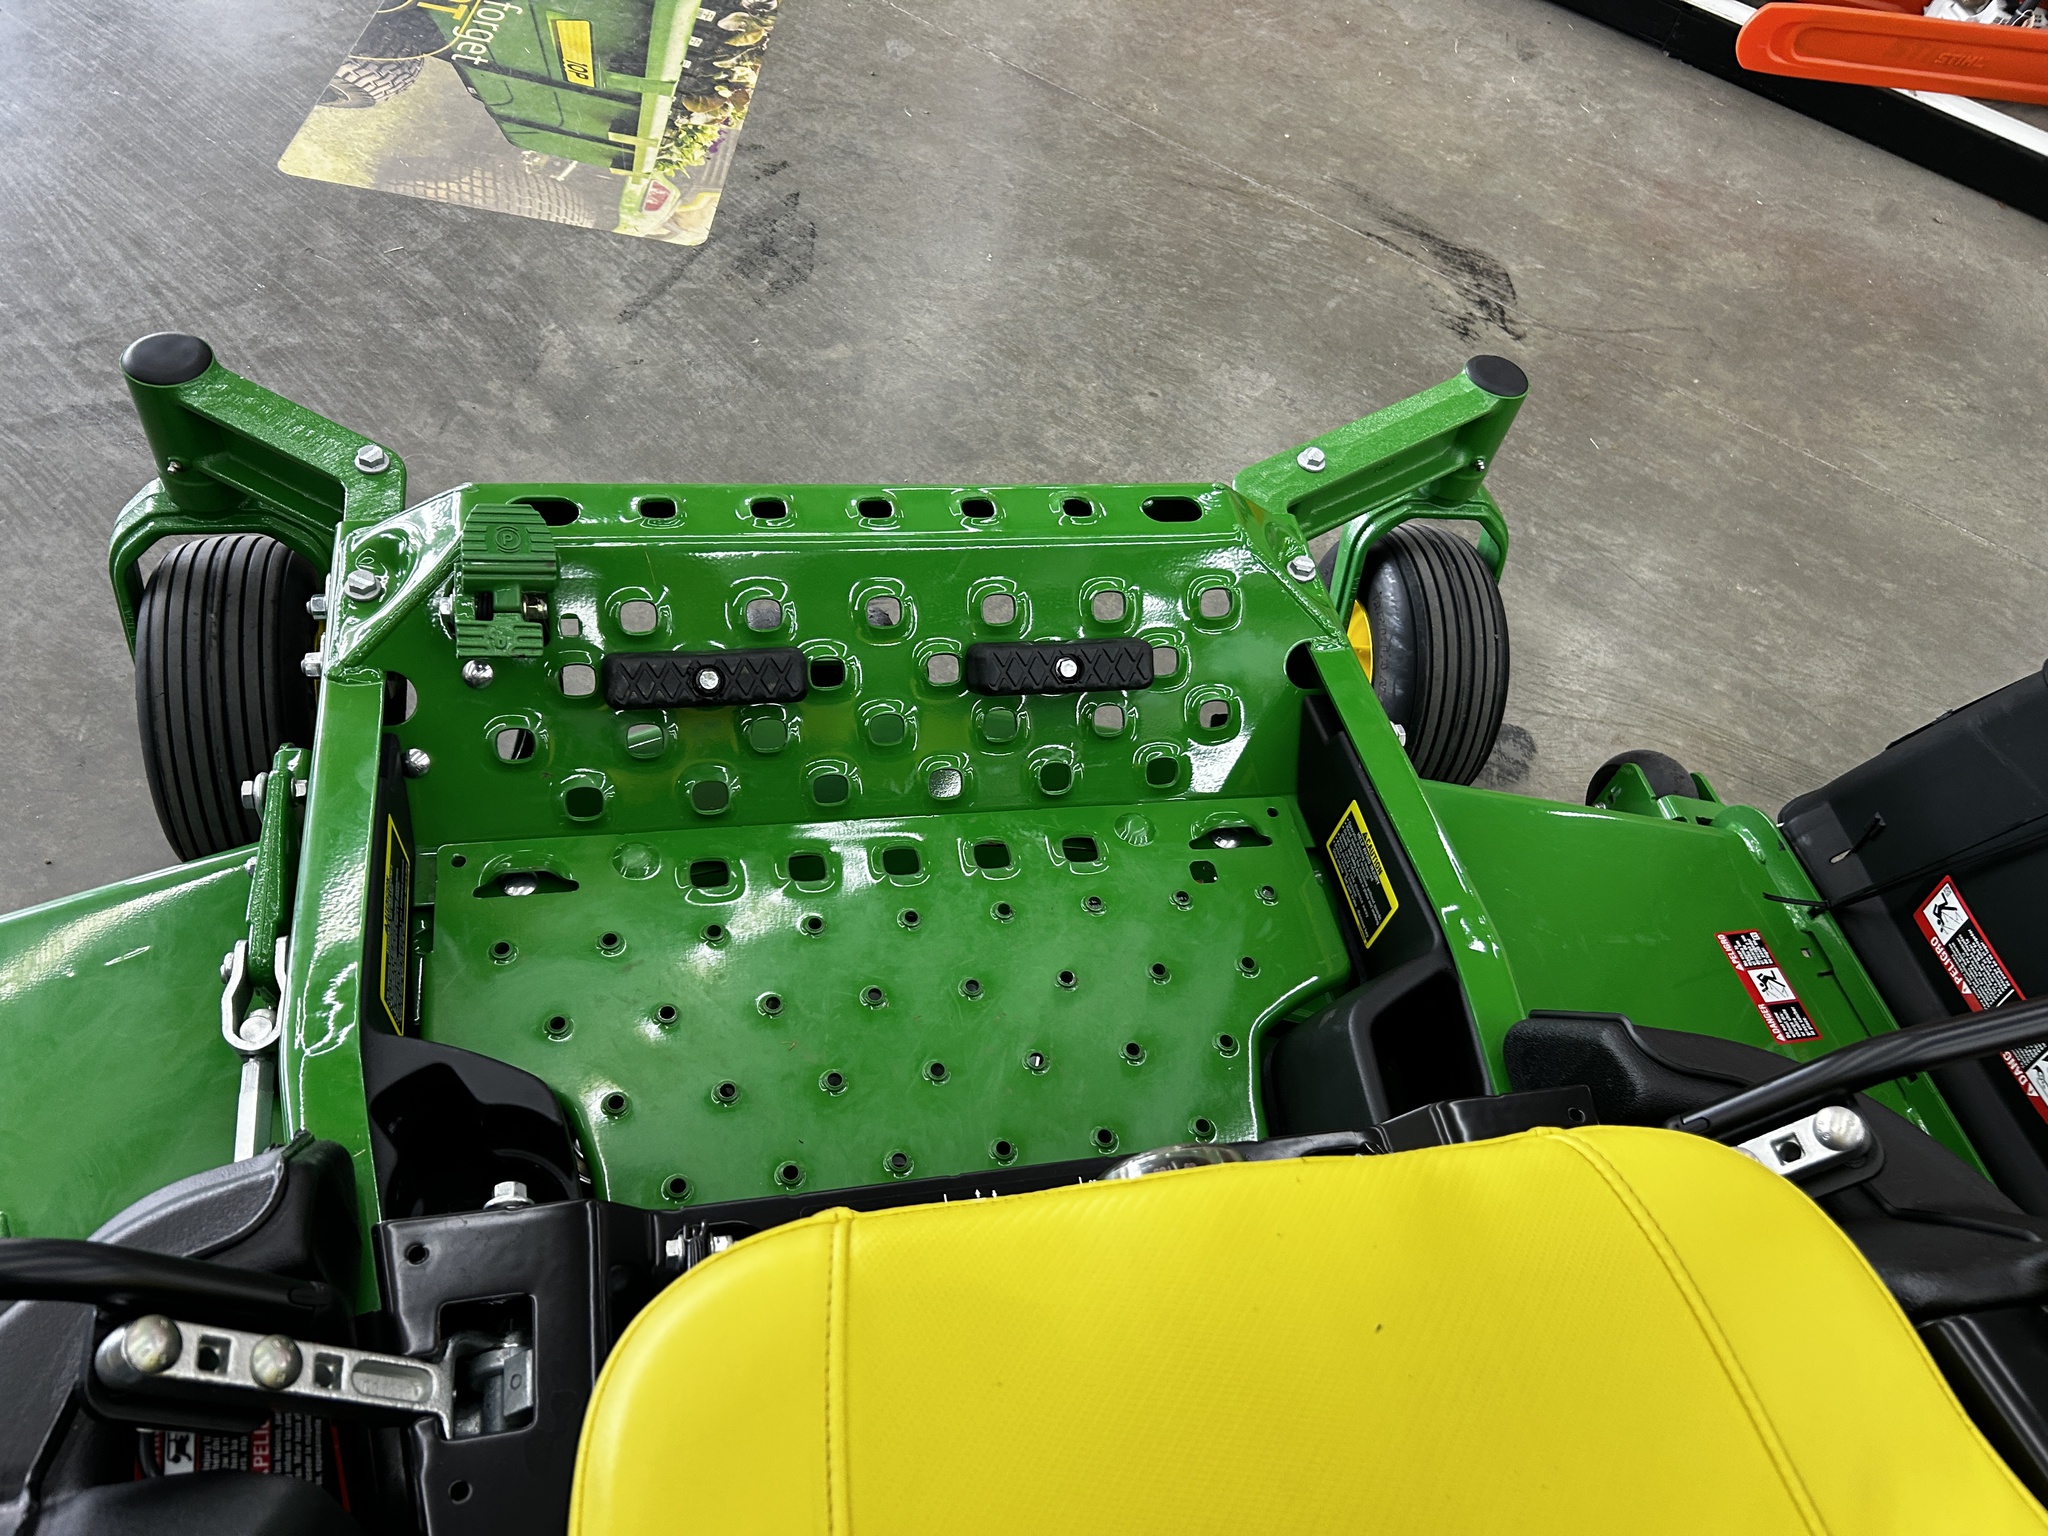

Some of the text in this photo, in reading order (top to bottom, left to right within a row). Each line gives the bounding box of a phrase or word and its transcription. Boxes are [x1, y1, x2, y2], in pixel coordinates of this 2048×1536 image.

[451, 0, 523, 65] forget
[1934, 51, 1985, 68] STIHL
[1365, 837, 1382, 876] CAUTION
[1717, 934, 1740, 963] PELIGRO
[1929, 934, 1963, 985] PELIGRO
[1757, 1003, 1780, 1033] DANGER
[2002, 1048, 2028, 1087] DANG
